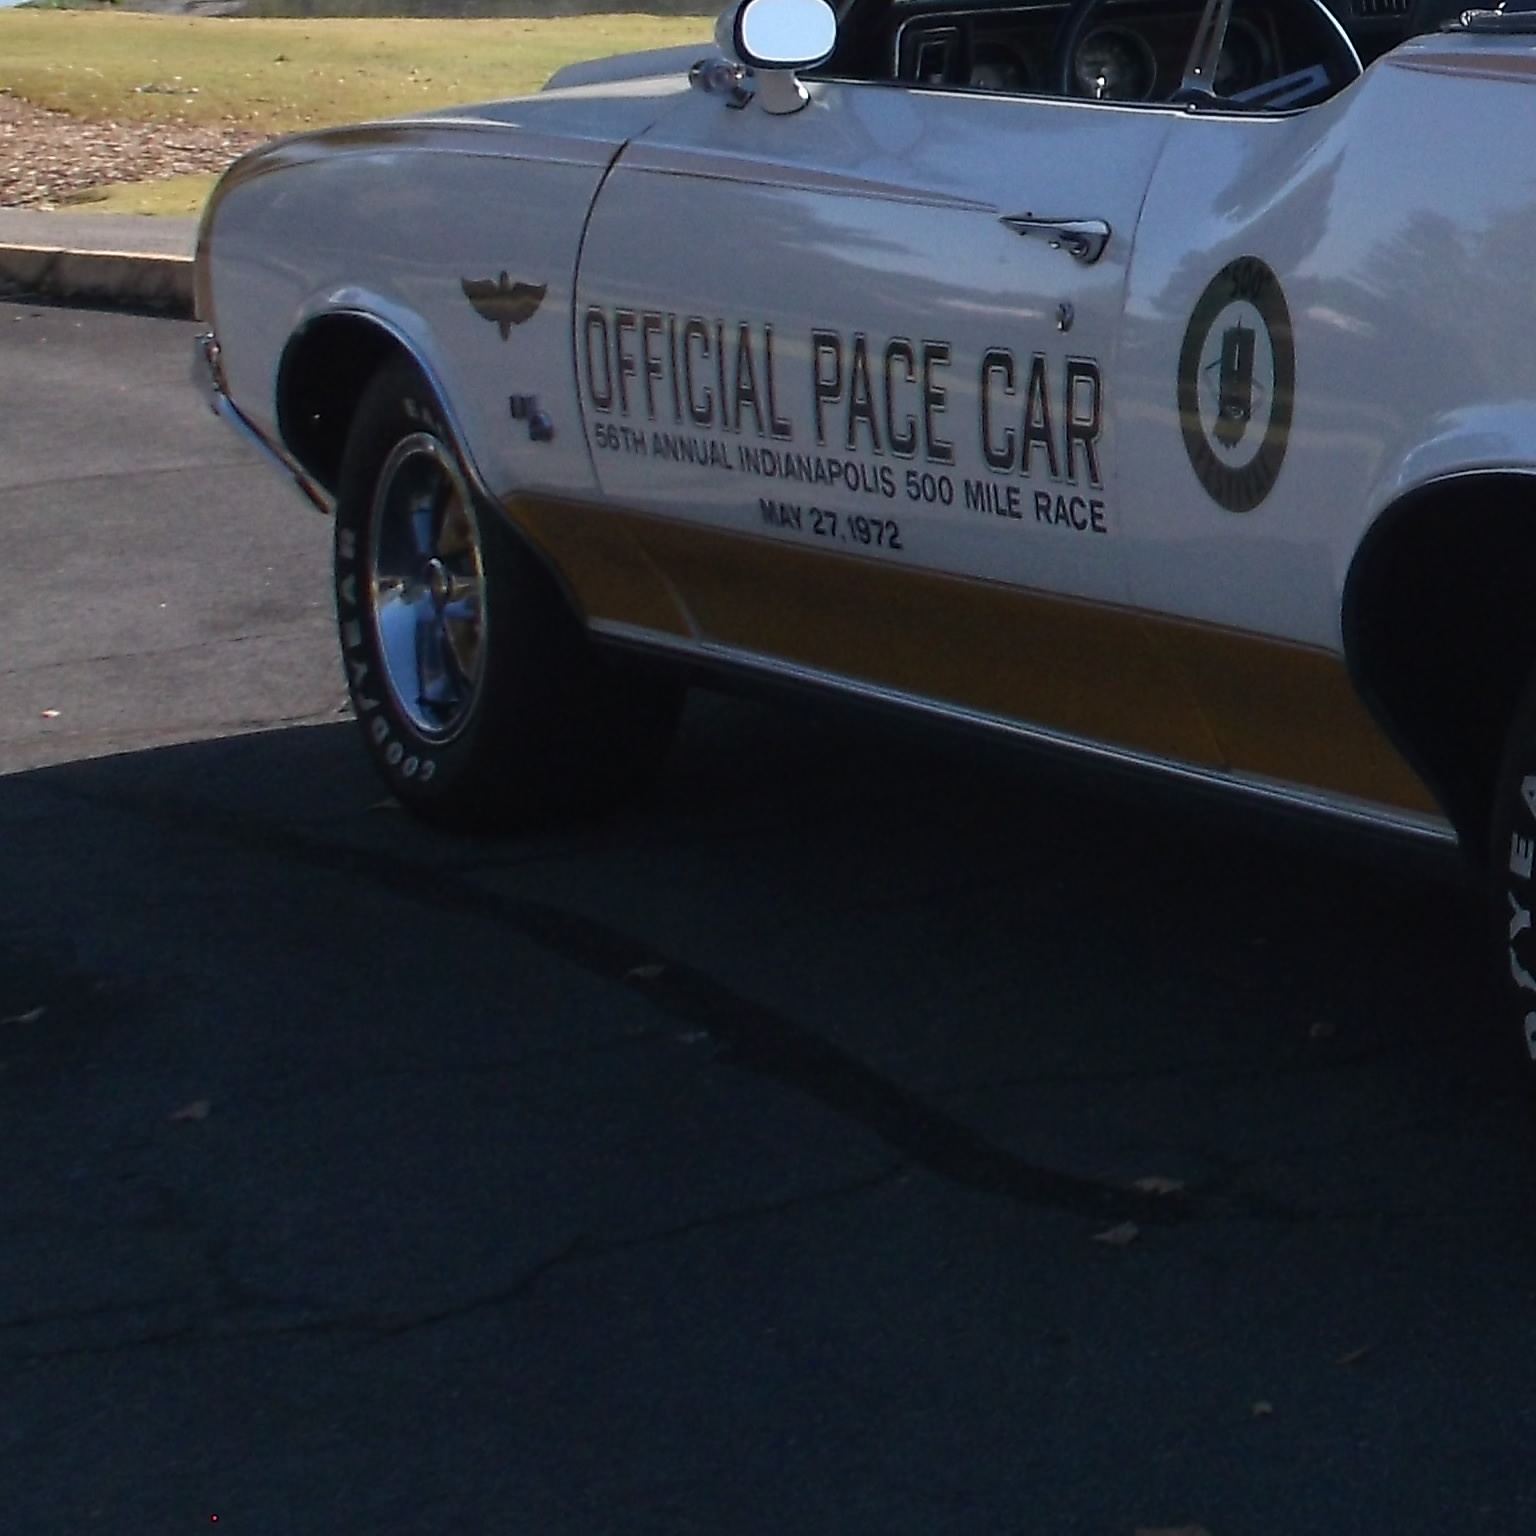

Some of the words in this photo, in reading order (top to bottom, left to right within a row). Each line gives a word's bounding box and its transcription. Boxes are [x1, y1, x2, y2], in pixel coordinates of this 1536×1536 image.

[586, 305, 792, 441] OFFICIAL
[811, 328, 955, 466] PACE
[981, 347, 1104, 490] CAR
[595, 423, 647, 455] 56TH
[653, 431, 733, 470] ANNUAL
[739, 445, 896, 499] INDIANAPOLIS
[906, 470, 954, 505] 500
[964, 479, 1023, 519] MILE
[1034, 491, 1107, 534] RACE
[759, 498, 803, 530] MAY
